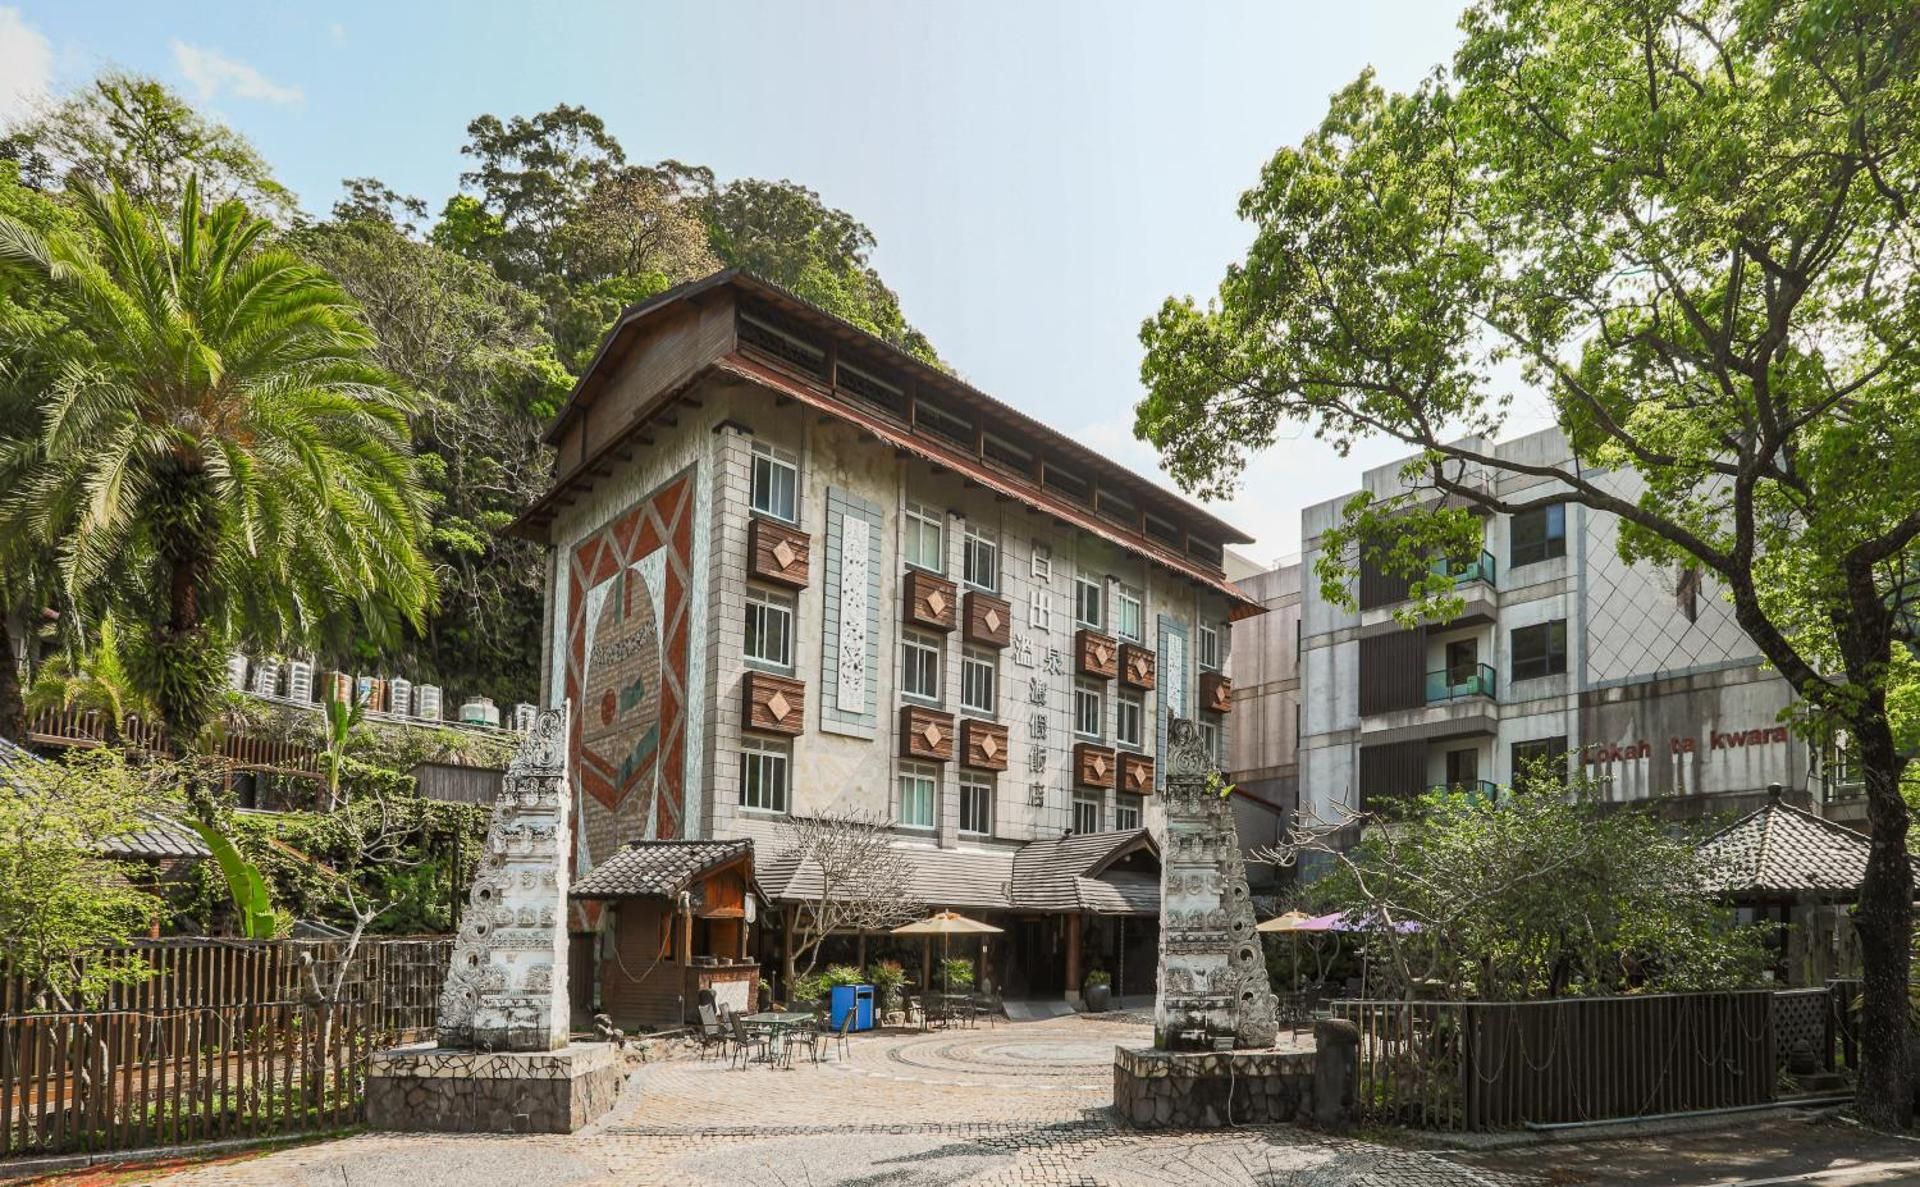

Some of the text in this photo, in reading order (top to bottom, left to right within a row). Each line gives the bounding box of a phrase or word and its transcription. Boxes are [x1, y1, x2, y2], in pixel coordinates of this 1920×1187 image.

[1583, 726, 1788, 764] Lokah ta kwara
